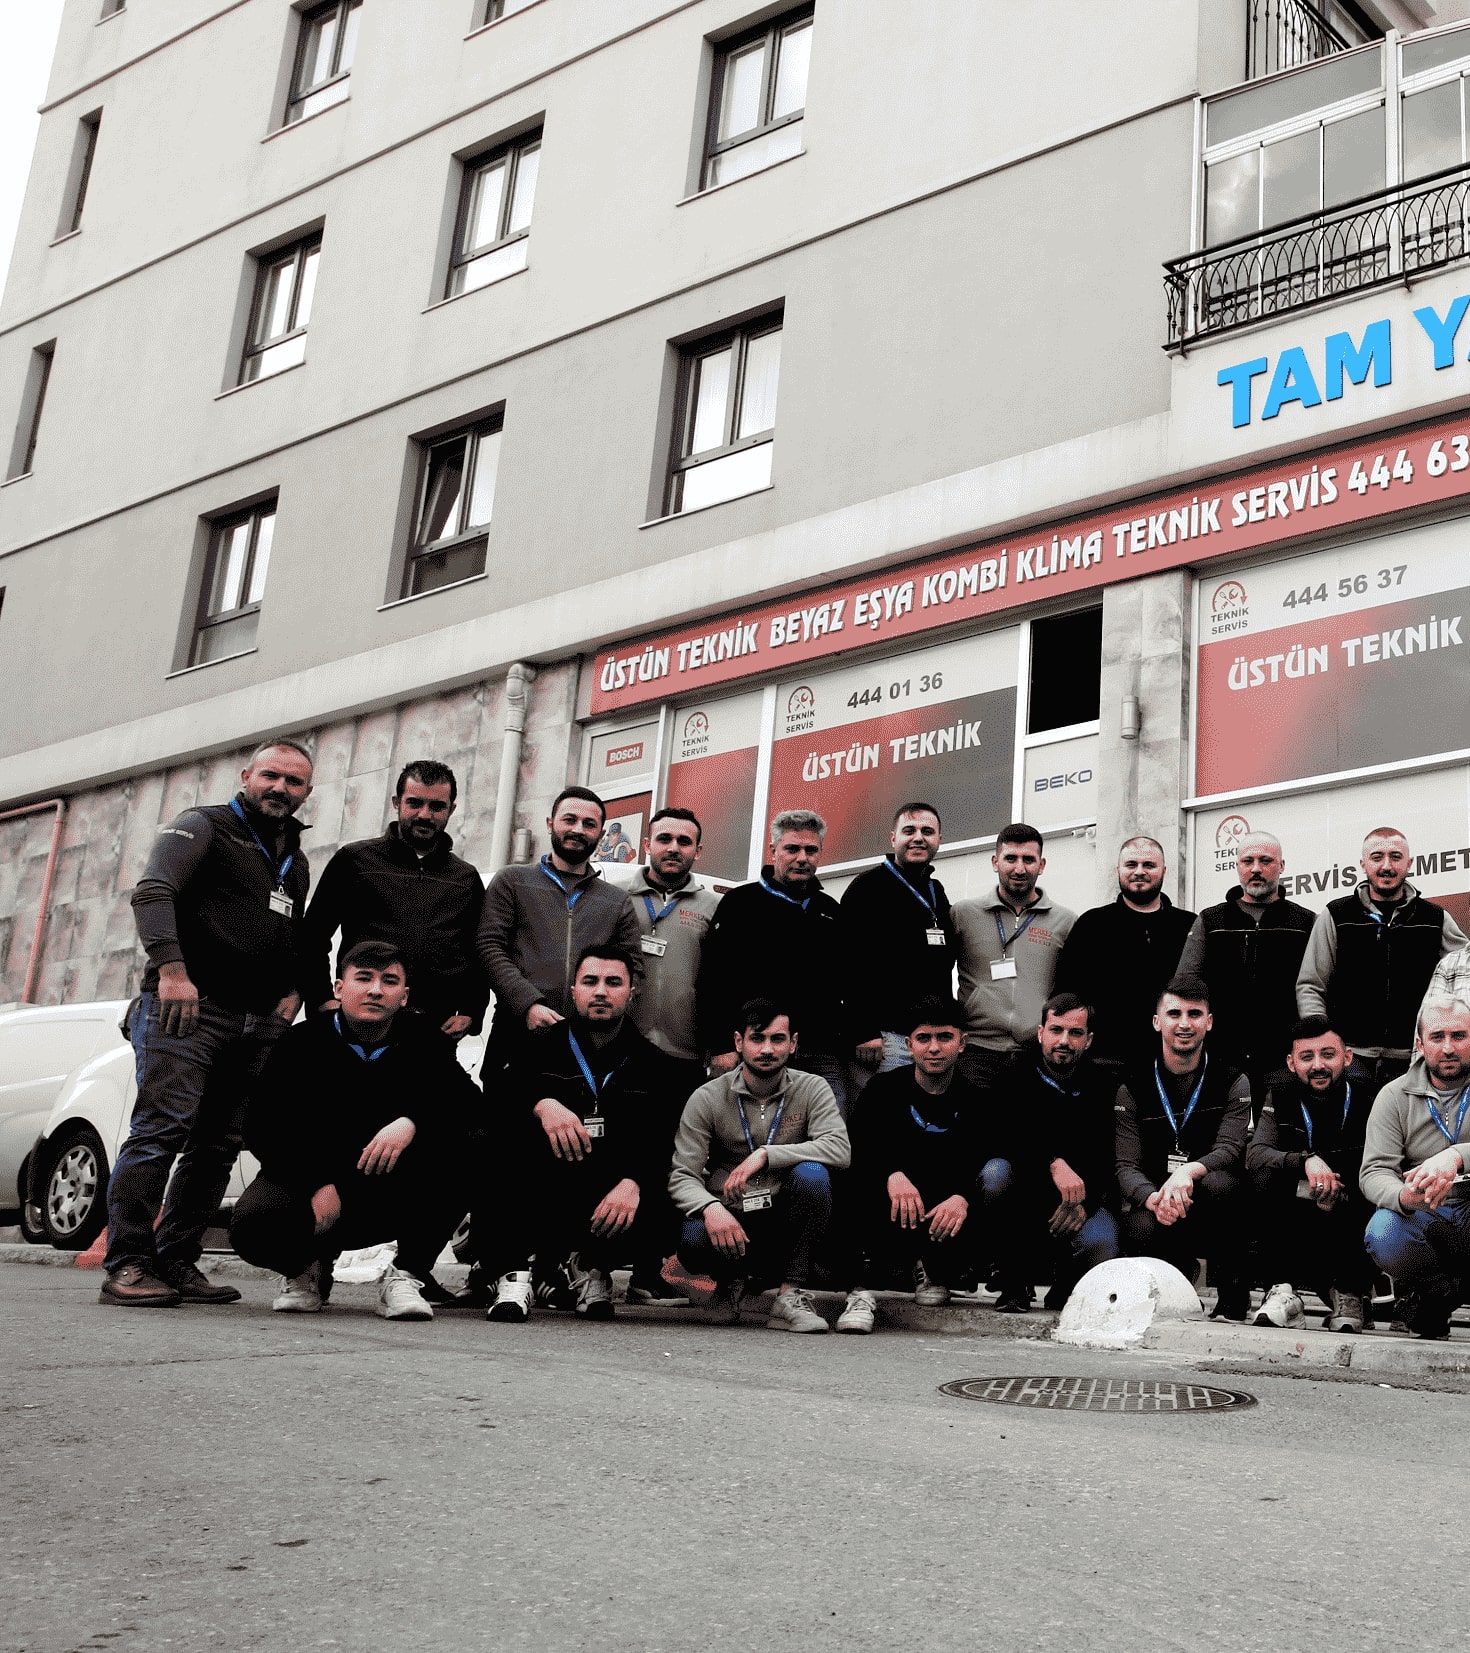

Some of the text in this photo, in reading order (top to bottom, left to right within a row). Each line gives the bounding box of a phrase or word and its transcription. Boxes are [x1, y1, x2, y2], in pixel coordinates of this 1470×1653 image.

[1217, 319, 1392, 429] TAM
[600, 646, 669, 691] ÜSTÜN
[677, 621, 758, 673] TEKNİK
[769, 599, 845, 649] BEYAZ
[854, 582, 913, 630] EŞYA
[922, 549, 1007, 608] KOMBİ
[1016, 529, 1102, 585] KLİMA
[1112, 496, 1222, 557] TEKNİK
[1232, 466, 1338, 528] SERVİS
[1347, 450, 1414, 496] 444
[1426, 434, 1470, 478] 63
[1282, 564, 1409, 609] 444 56 37
[1210, 606, 1249, 623] TEKNİK
[1211, 619, 1248, 635] SERVİS
[1227, 615, 1463, 691] ÜSTÜN TEKNİK
[846, 672, 944, 710] 444 01 36
[786, 709, 815, 723] TEKNİK
[785, 720, 814, 734] SERVİS
[682, 735, 710, 747] TEKNİK
[803, 720, 982, 782] ÜSTÜN TEKNİK
[609, 746, 640, 763] BOSCH
[681, 745, 708, 758] SERVİS
[1033, 769, 1093, 793] BEKO
[1214, 847, 1238, 859] TEK
[1278, 863, 1357, 898] ERVİS
